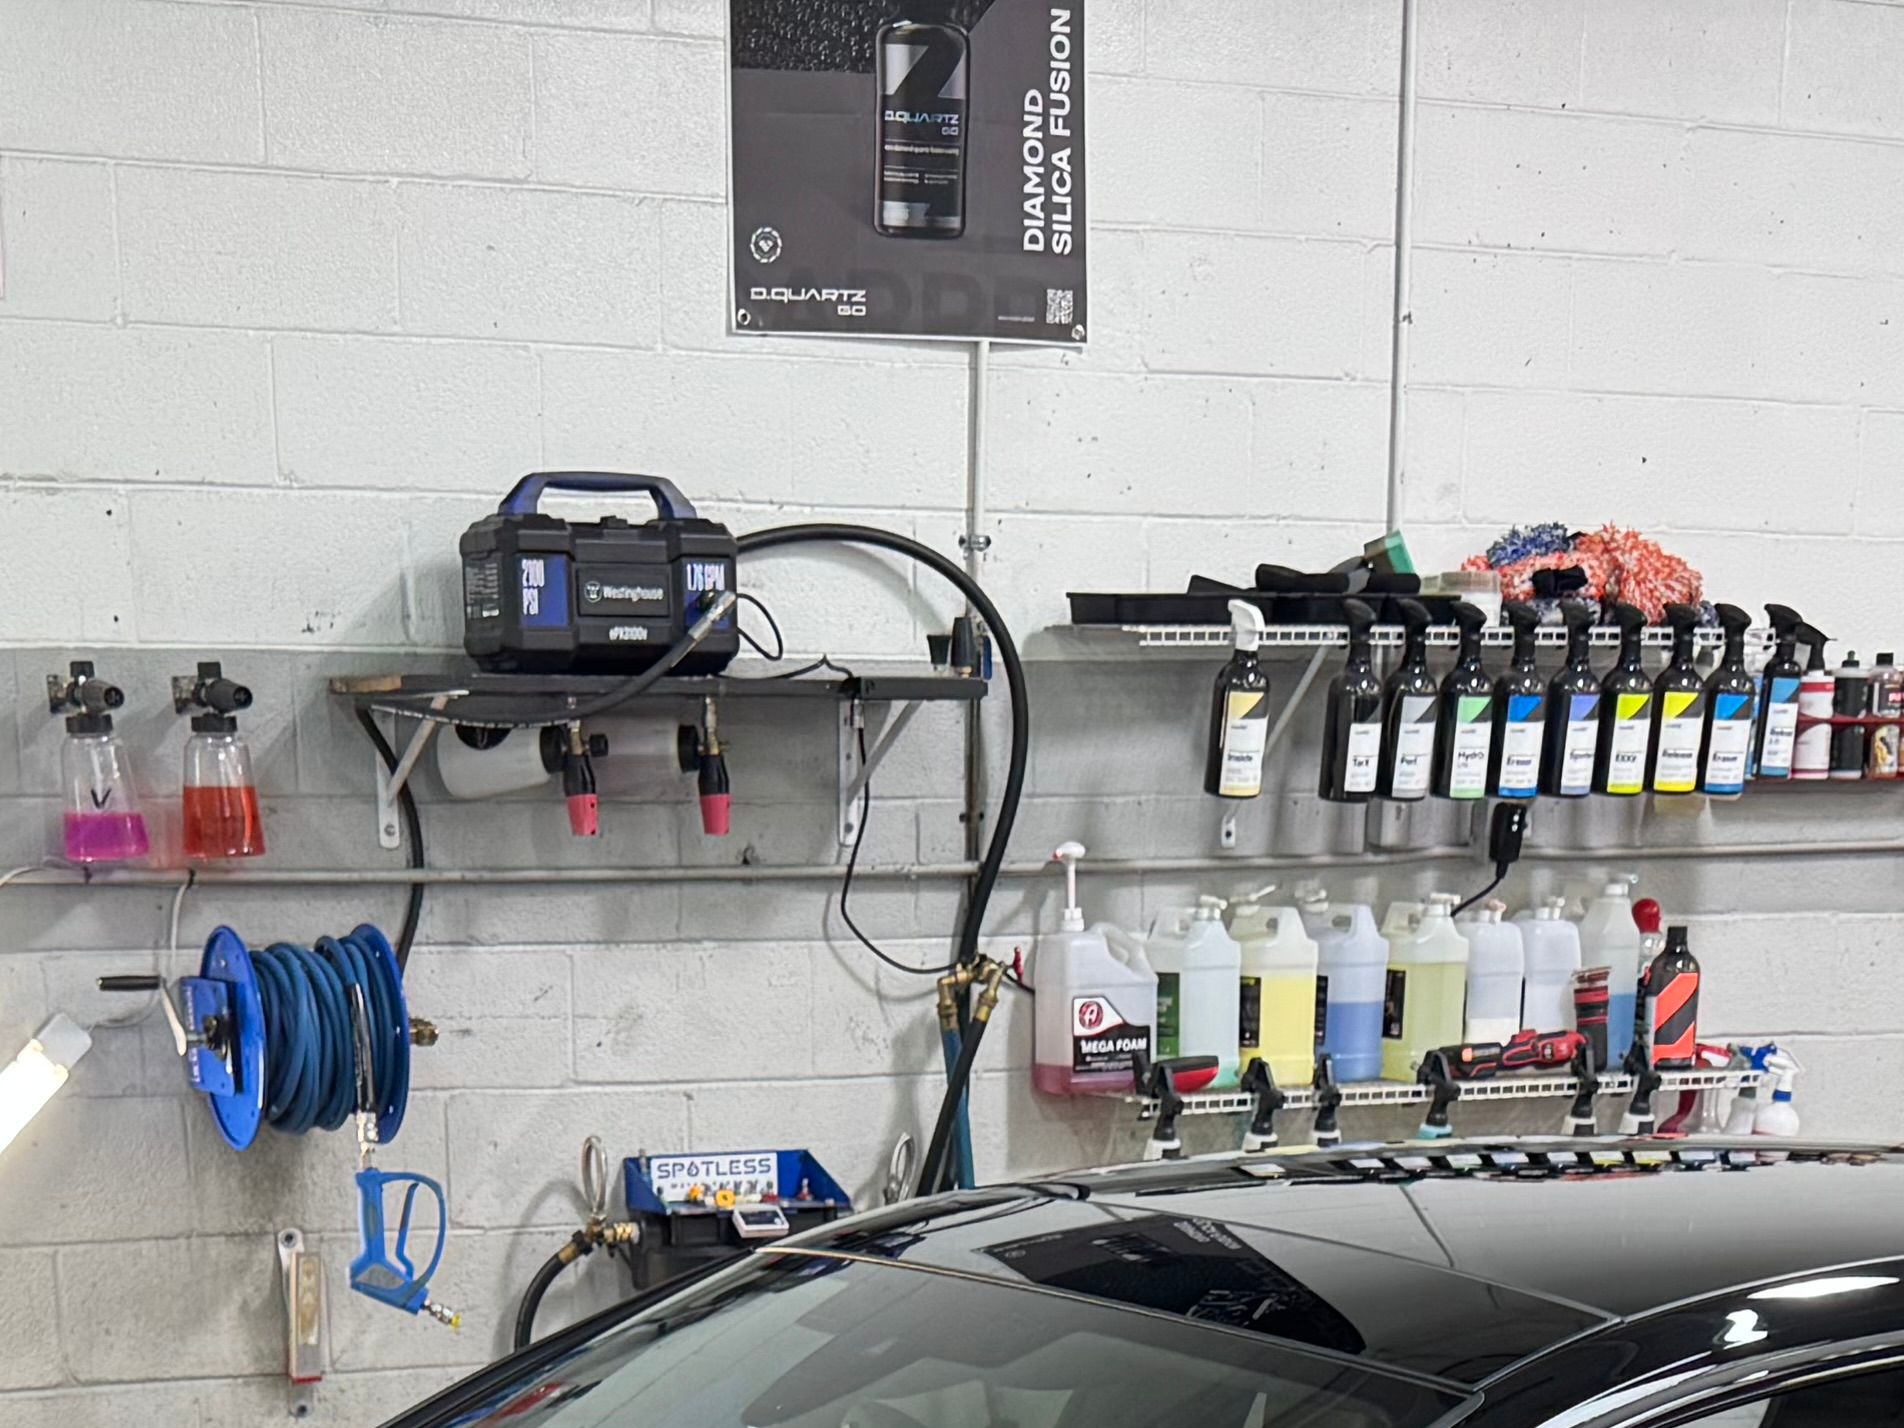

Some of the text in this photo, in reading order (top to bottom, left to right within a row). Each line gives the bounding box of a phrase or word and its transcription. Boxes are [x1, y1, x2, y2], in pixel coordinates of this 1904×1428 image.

[1050, 8, 1073, 255] SILICA FUSION
[1022, 88, 1045, 252] DIAMOND
[750, 287, 866, 303] D.QUARTZ
[522, 588, 540, 616] PSI
[603, 586, 665, 602] Westinghouse
[1080, 1037, 1148, 1053] MEGA FOAM
